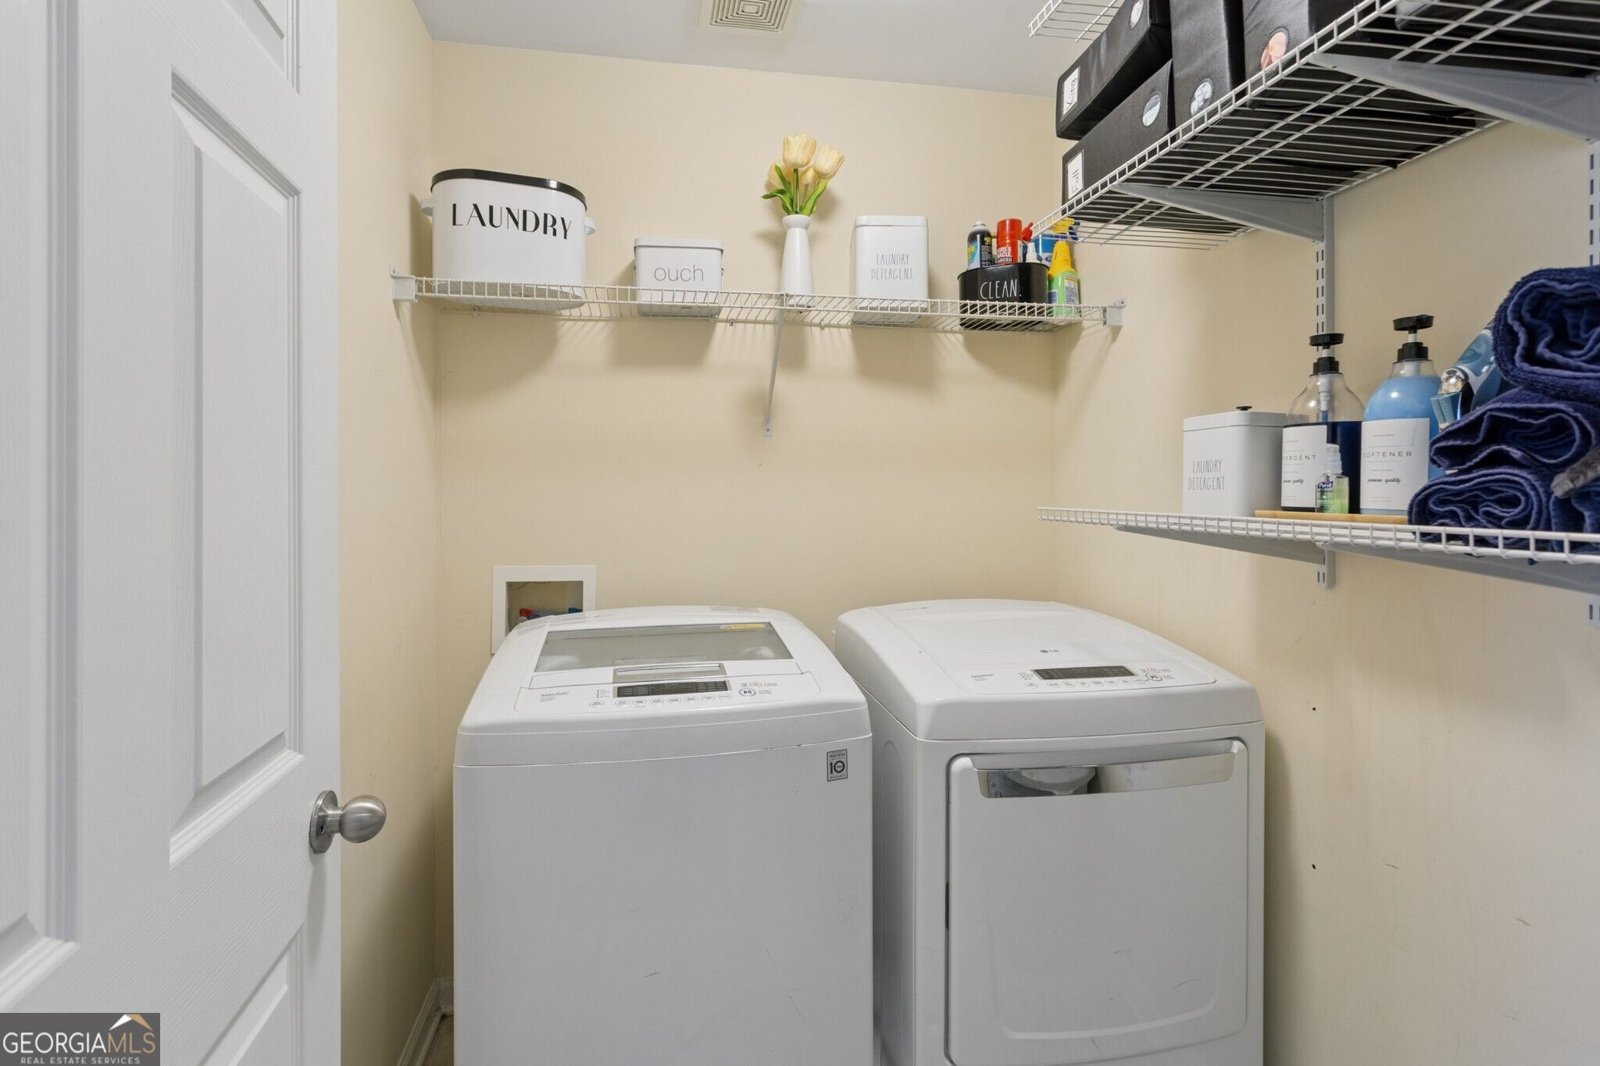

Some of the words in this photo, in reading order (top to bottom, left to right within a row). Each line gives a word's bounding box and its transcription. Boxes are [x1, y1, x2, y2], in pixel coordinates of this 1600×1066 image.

[452, 203, 572, 240] LAUNDRY
[876, 253, 911, 267] LAUNDRY
[653, 264, 704, 282] ouch
[871, 267, 913, 281] DETERGENT
[1192, 459, 1222, 473] LAUNDRY
[1188, 475, 1225, 491] DETERGENT
[829, 760, 846, 775] 10
